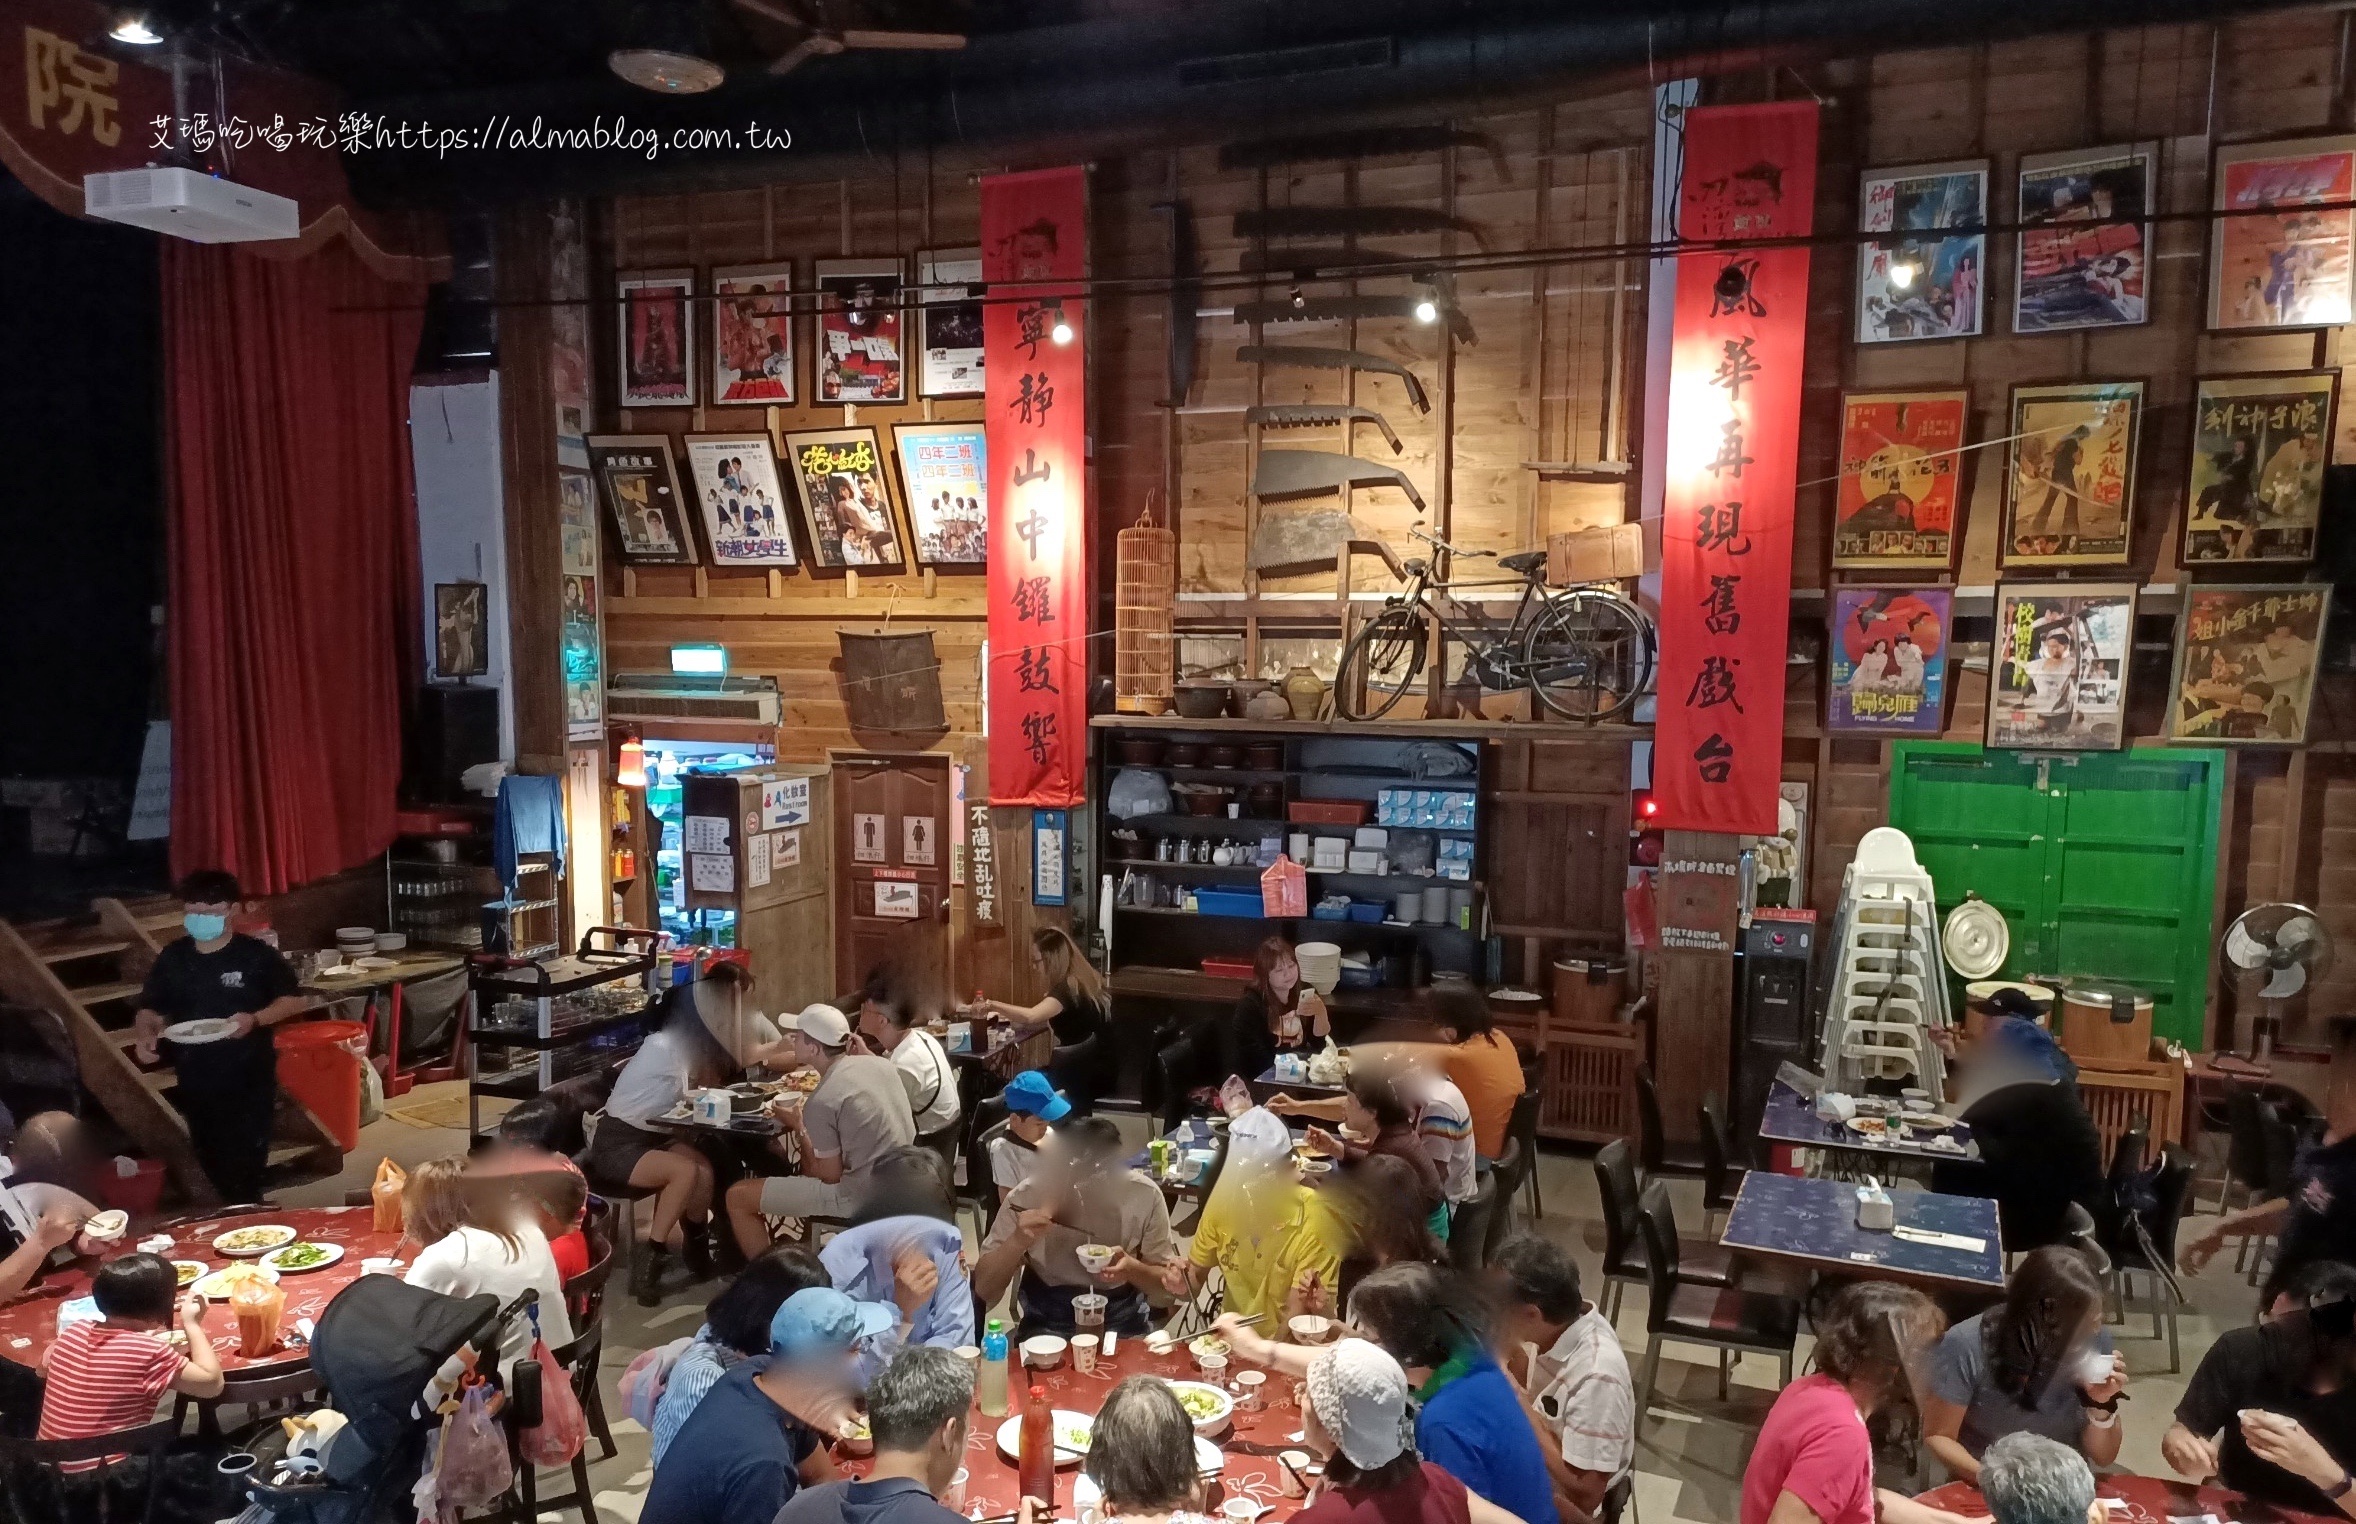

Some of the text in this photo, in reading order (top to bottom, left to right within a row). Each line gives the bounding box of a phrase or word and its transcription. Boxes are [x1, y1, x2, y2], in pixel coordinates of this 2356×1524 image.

[25, 25, 121, 147] 院
[918, 444, 973, 460] 四年二班
[922, 464, 976, 479] 四年二班
[1009, 305, 1059, 766] 寧靜山中鑼鼓響
[1894, 715, 1915, 723] HOME
